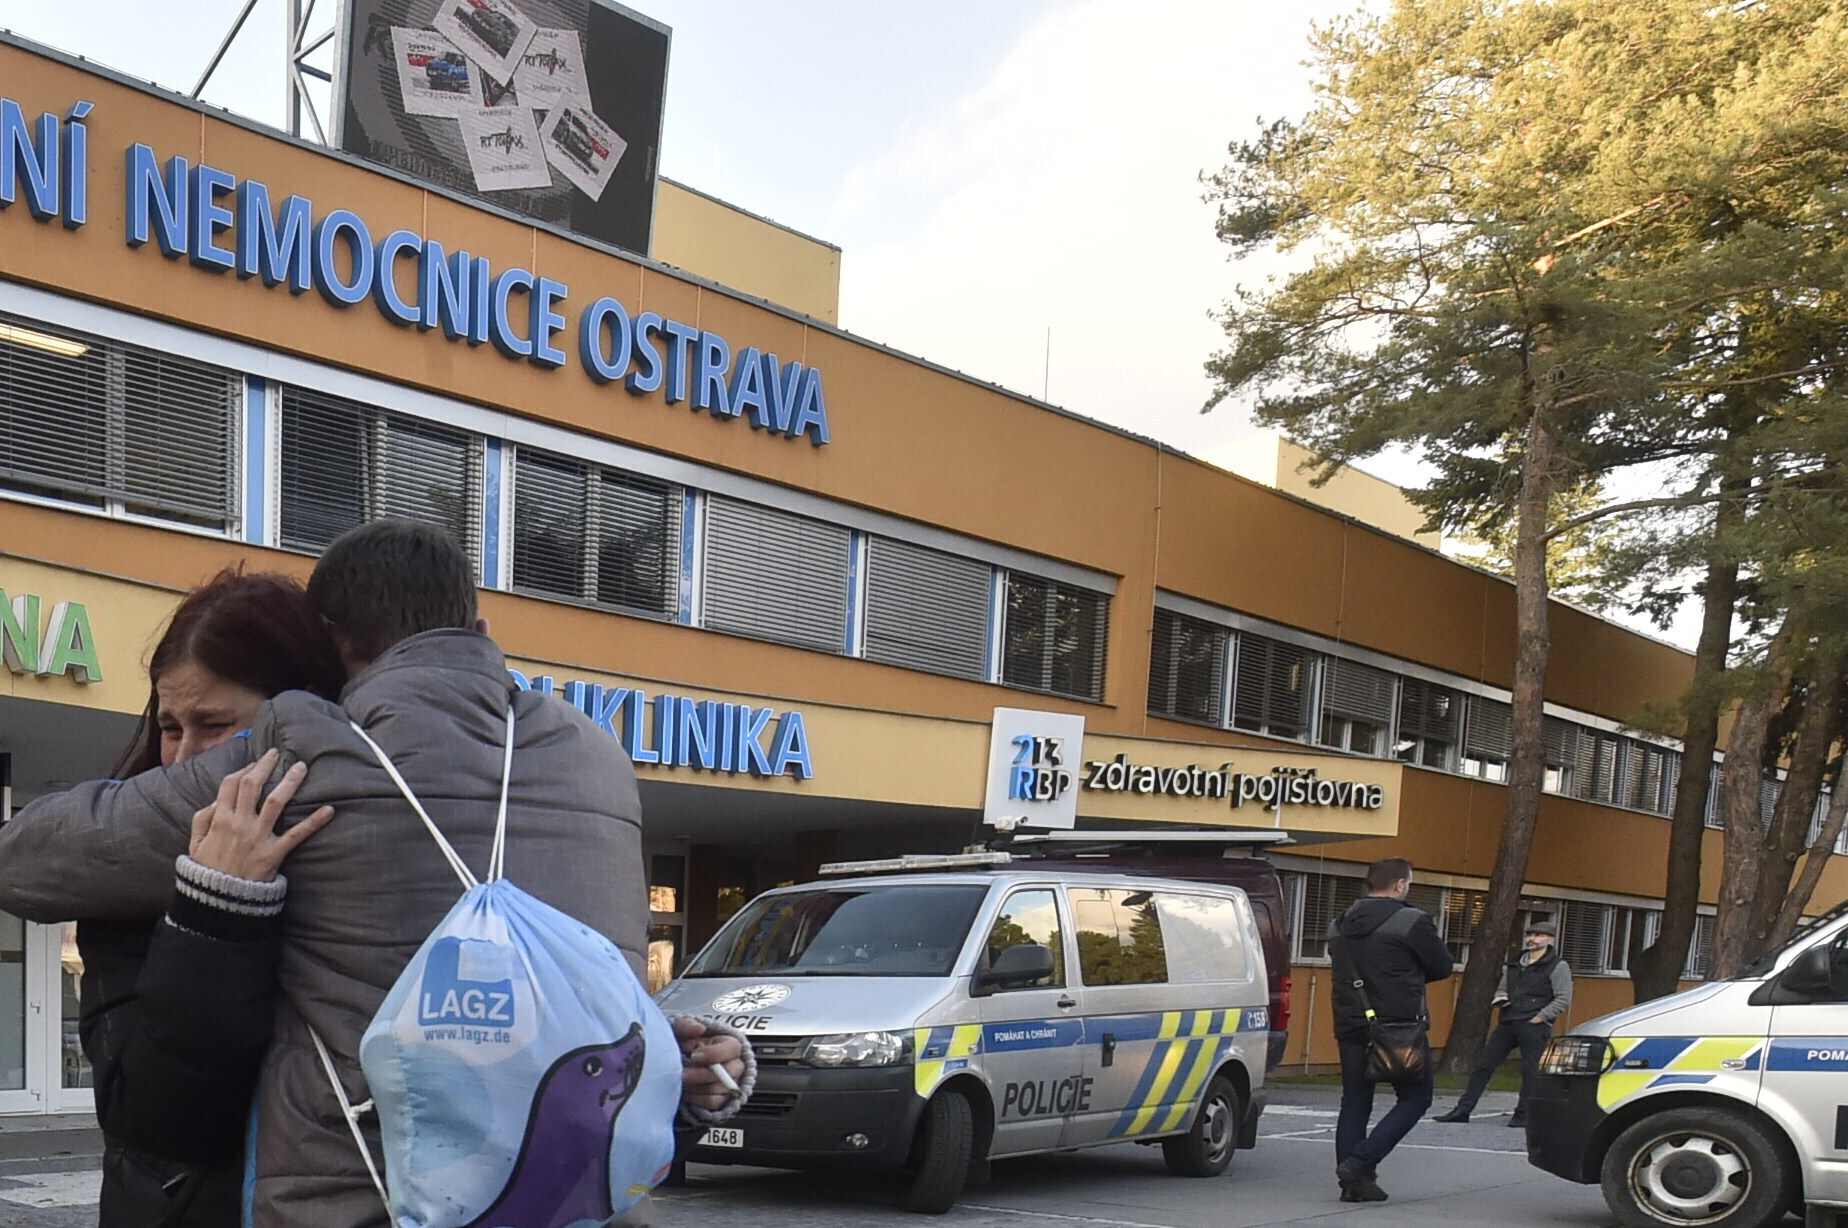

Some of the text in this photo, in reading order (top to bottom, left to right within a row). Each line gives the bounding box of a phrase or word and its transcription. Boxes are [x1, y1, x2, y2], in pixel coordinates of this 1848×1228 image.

[126, 141, 569, 370] NEMOCNICE
[579, 297, 831, 448] OSTRAVA
[1011, 734, 1064, 767] 213
[1008, 766, 1072, 802] RBP
[1086, 754, 1235, 800] zdravotní
[422, 989, 510, 1020] LAGZ
[424, 1027, 511, 1044] www.lagz.de
[1001, 1077, 1094, 1117] POLICIE
[707, 1129, 737, 1145] 1648
